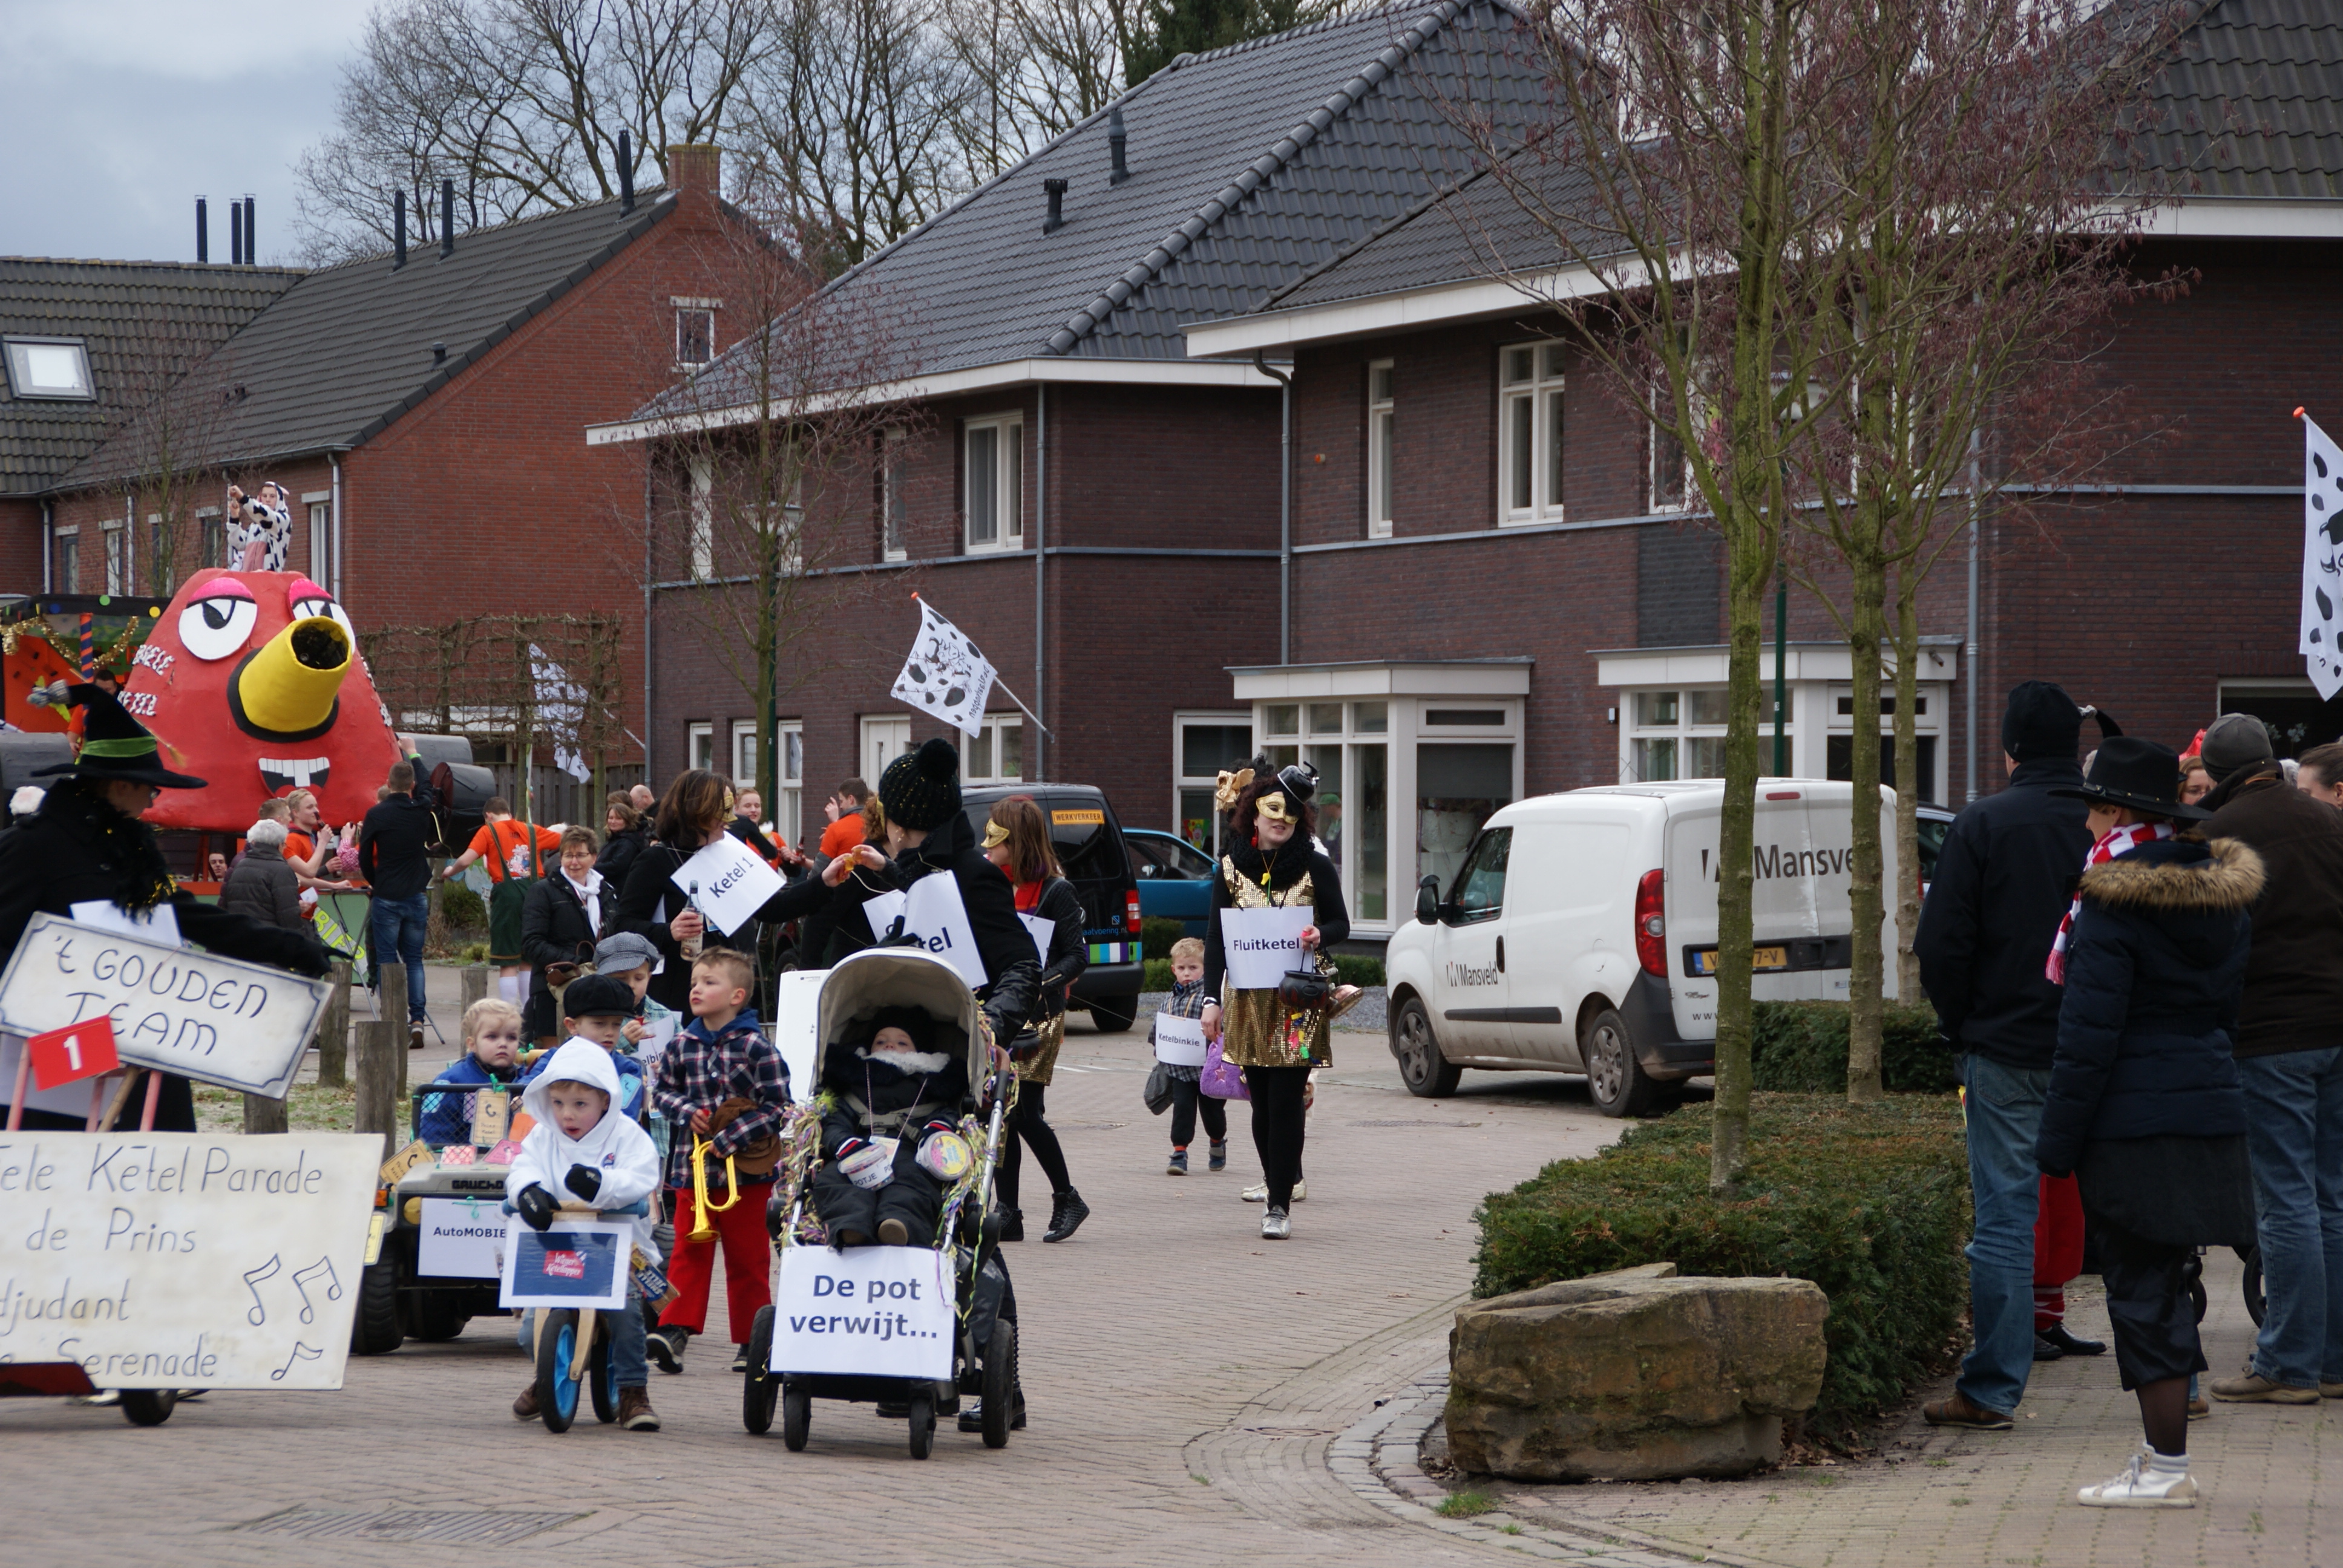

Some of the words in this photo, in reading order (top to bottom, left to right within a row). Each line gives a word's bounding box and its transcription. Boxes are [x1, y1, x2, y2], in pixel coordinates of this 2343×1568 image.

[709, 862, 747, 898] Ketel
[742, 857, 754, 868] 1
[1233, 937, 1300, 951] Fluitketel
[93, 949, 269, 1019] GOUDEN
[1460, 961, 1499, 987] Mansveld
[66, 991, 218, 1056] TEAM
[1158, 1032, 1200, 1047] Ketelbinkie
[63, 1034, 84, 1071] 1
[201, 1146, 323, 1195] Parade
[25, 1207, 68, 1252] de
[105, 1206, 197, 1253] Prins
[813, 1274, 854, 1297] De
[867, 1278, 921, 1304] pot
[789, 1311, 937, 1341] verwijt...
